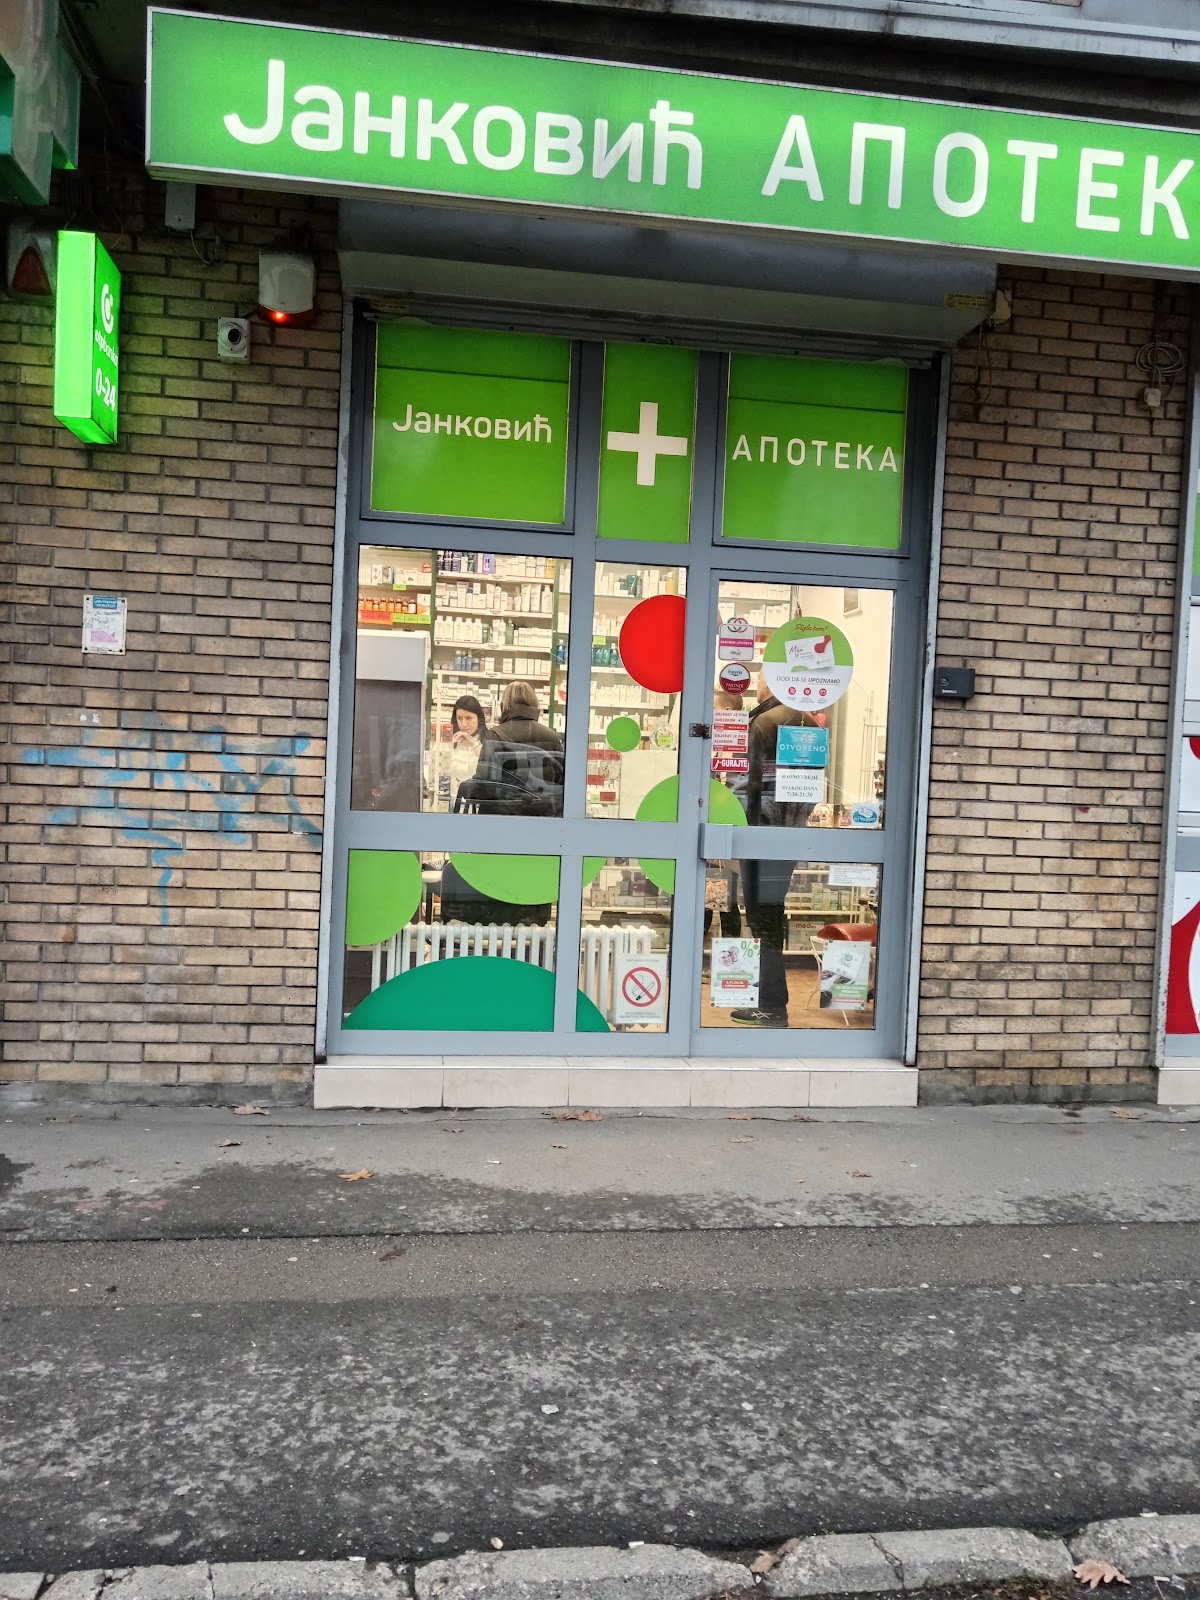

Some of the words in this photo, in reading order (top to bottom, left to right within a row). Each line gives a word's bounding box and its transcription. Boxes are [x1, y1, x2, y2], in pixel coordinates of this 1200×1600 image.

[223, 59, 703, 190] Јанковић
[761, 114, 1195, 240] АПОТЕК
[95, 367, 116, 412] 0-24
[392, 404, 553, 444] Јанковић
[732, 434, 899, 473] АПОТЕКА
[721, 759, 748, 768] GURAJTE
[780, 743, 826, 753] OTVORENO
